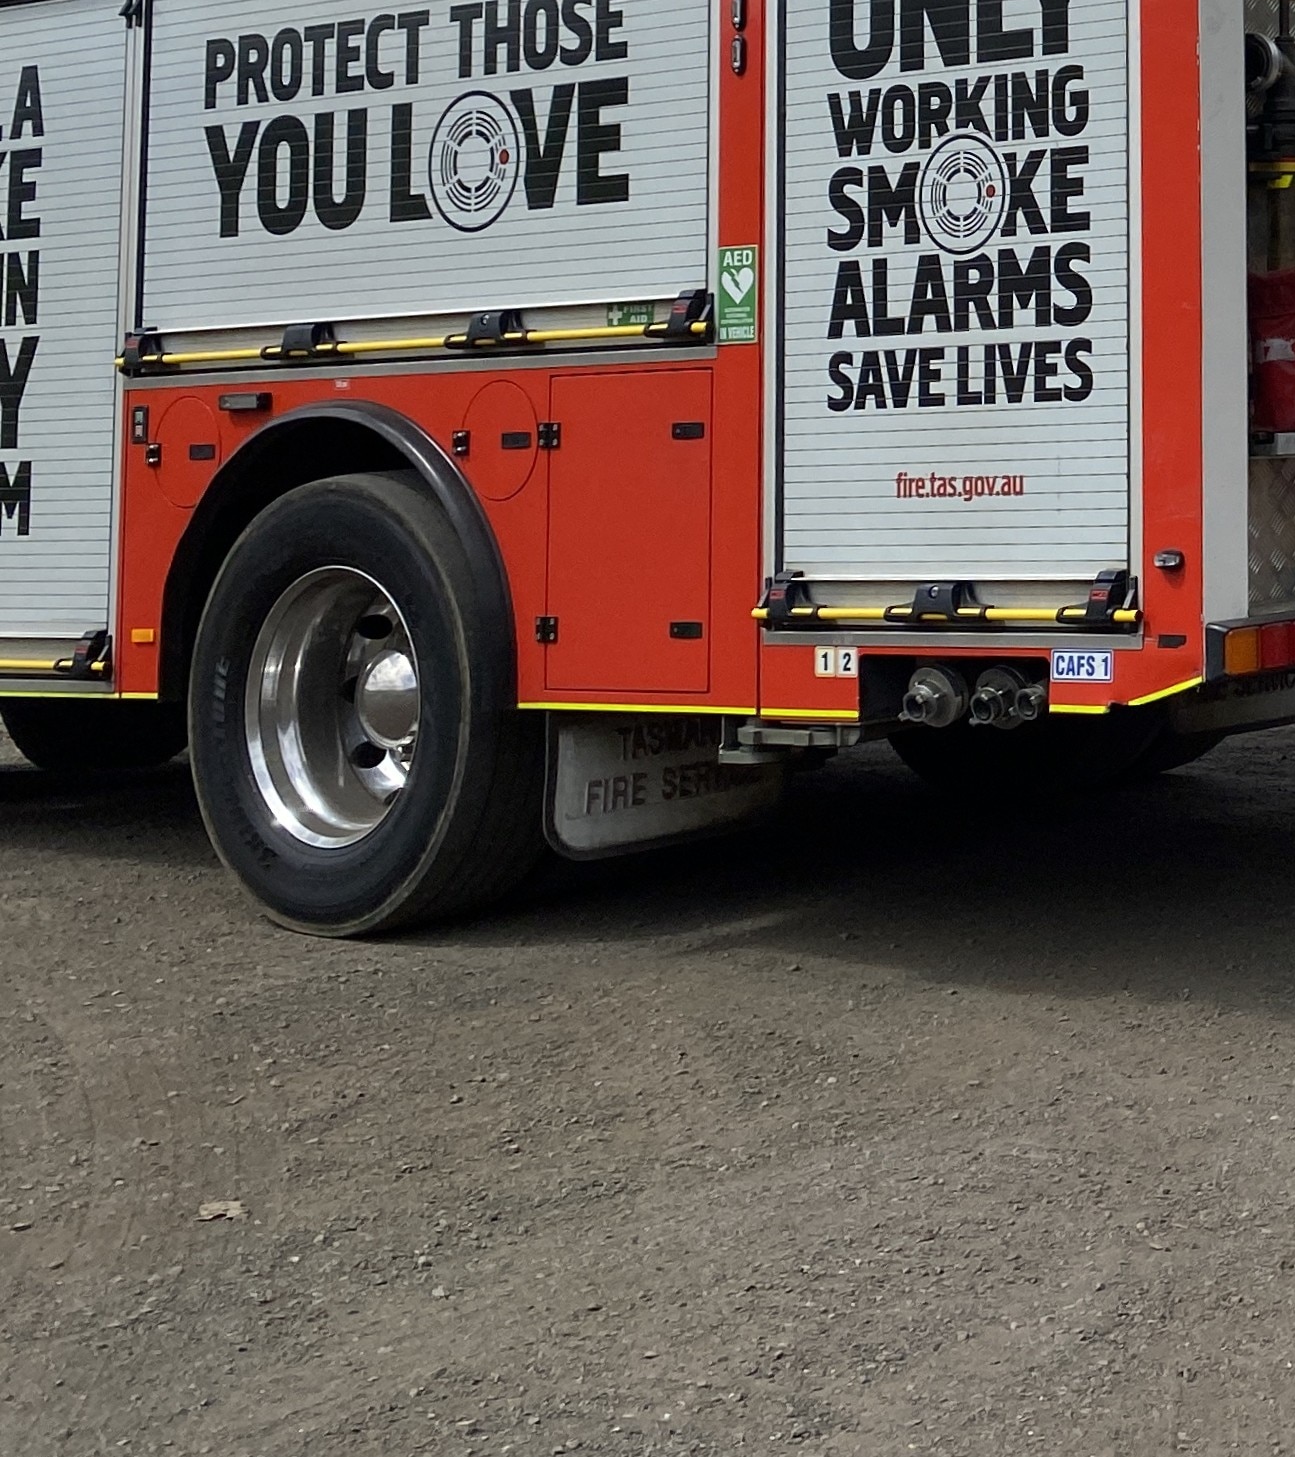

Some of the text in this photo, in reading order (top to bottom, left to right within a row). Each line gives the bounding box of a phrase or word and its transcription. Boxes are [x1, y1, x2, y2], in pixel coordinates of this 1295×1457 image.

[204, 10, 430, 110] PROTECT
[827, 64, 1090, 157] WORKING
[204, 108, 368, 238] YOU
[827, 134, 1091, 254] SMOKE
[723, 249, 753, 267] AED
[623, 304, 653, 313] FIRST
[827, 242, 1093, 339] ALARMS
[629, 314, 649, 324] AID
[719, 325, 755, 340] IN VEHICLE
[827, 337, 1094, 412] SAVE LIVES
[895, 471, 1025, 501] fire.tas.gov.au
[821, 652, 851, 671] 1 2
[1055, 654, 1110, 677] CAFS 1
[583, 772, 649, 817] FIRE
